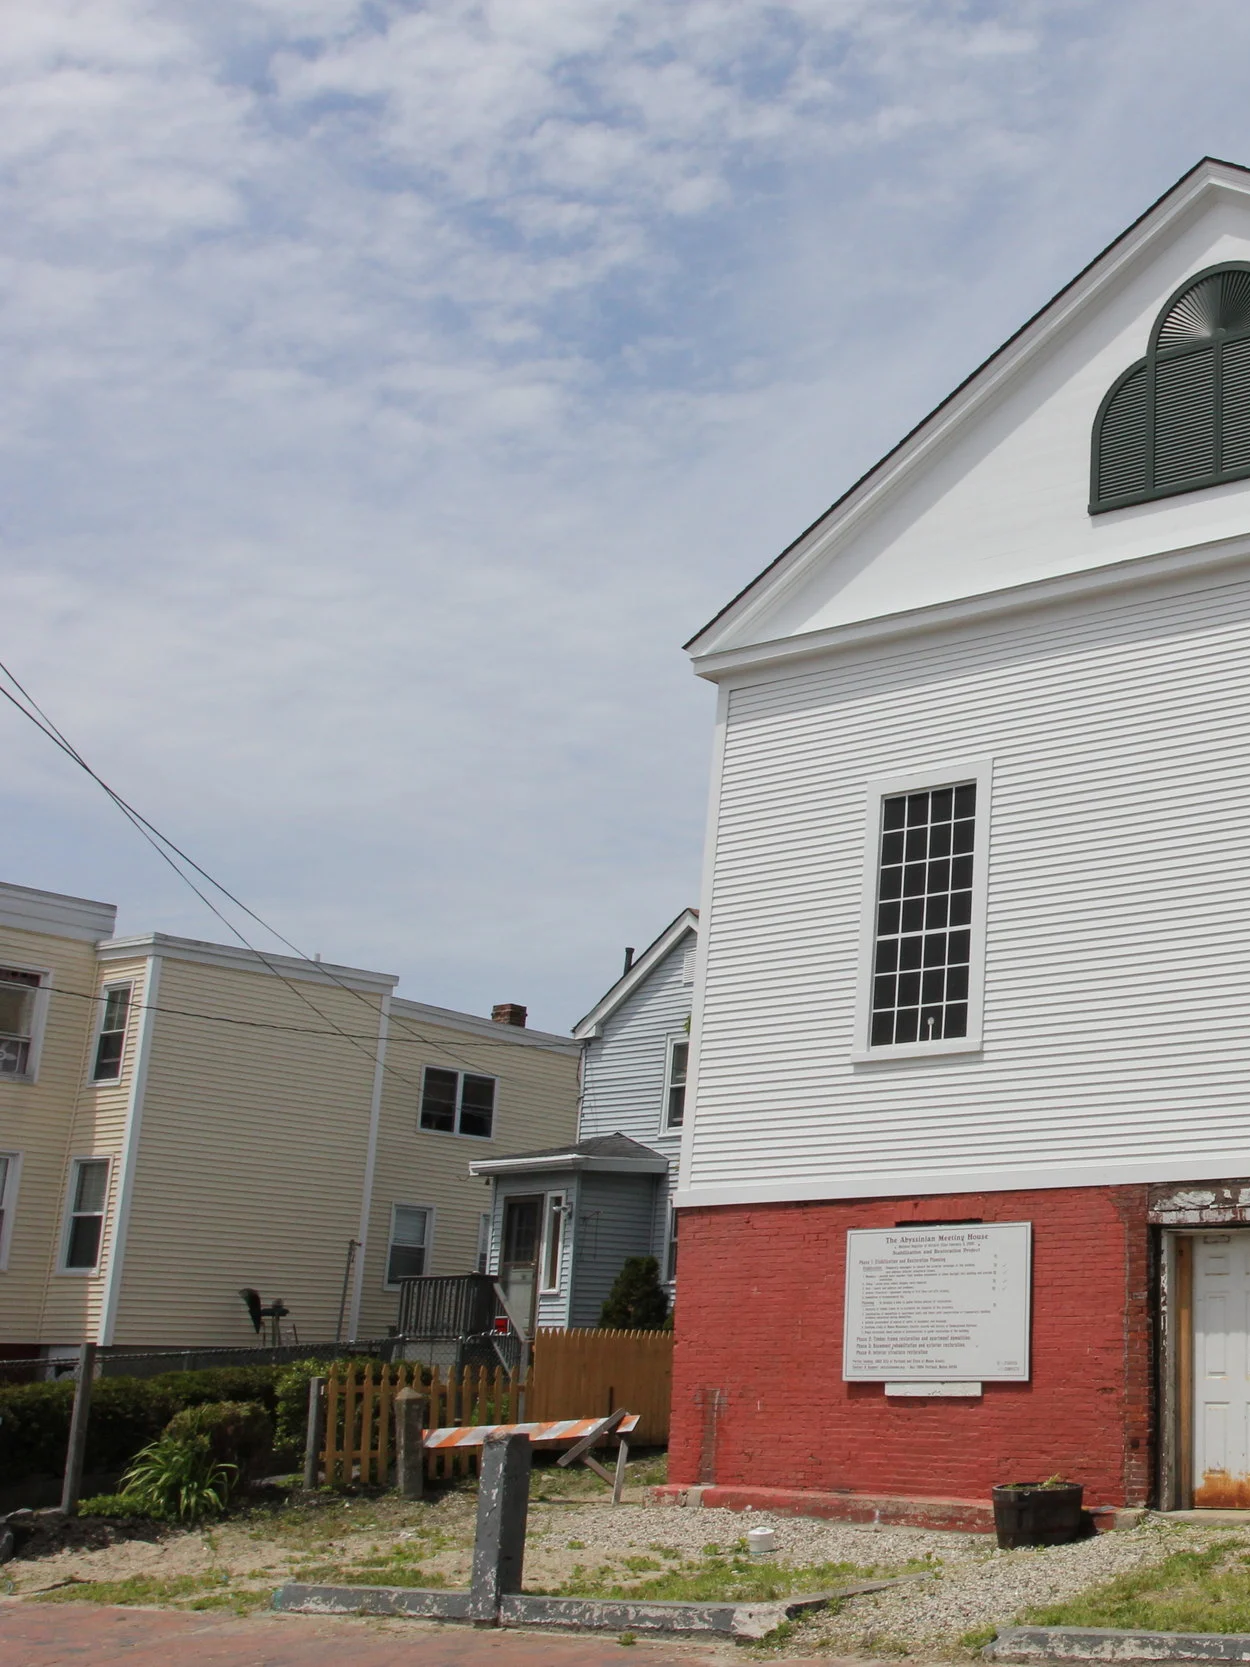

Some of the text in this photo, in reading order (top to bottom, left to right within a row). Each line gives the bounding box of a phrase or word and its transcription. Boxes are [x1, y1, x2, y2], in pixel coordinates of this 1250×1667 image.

[900, 1235, 936, 1244] Abyssinian
[938, 1234, 965, 1242] Meeting
[967, 1233, 989, 1241] House
